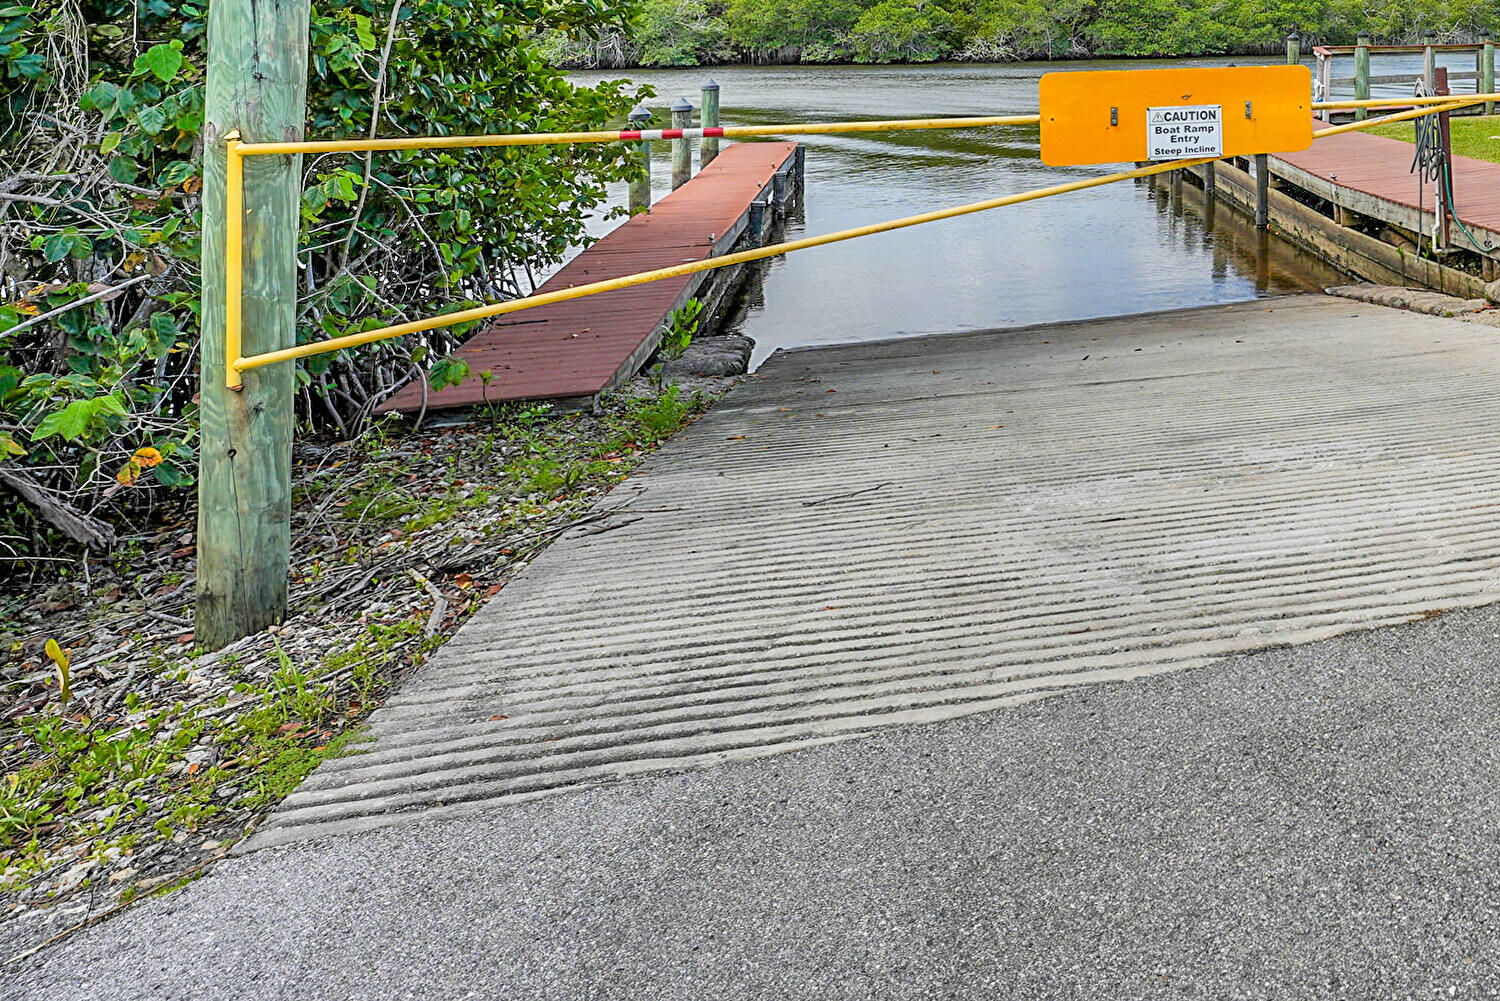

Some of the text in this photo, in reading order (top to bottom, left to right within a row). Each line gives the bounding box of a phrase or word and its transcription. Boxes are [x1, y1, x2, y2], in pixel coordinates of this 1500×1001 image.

[1164, 110, 1216, 121] CAUTION
[1155, 125, 1214, 134] Boat Ramp
[1171, 135, 1199, 143] Entry
[1155, 145, 1215, 155] Steep Incline
